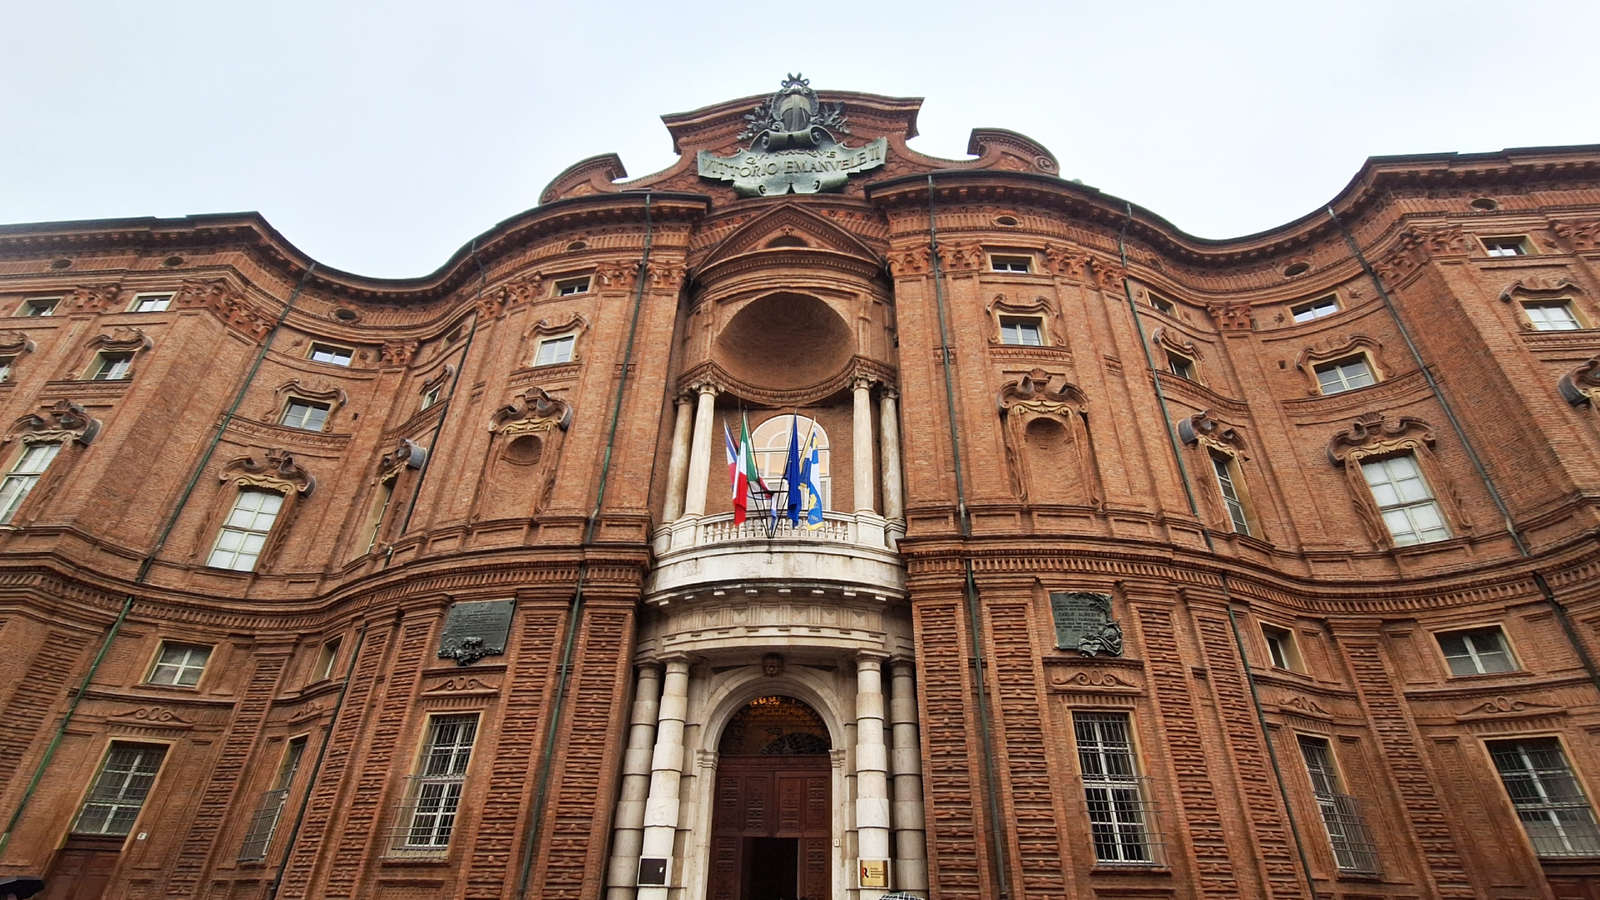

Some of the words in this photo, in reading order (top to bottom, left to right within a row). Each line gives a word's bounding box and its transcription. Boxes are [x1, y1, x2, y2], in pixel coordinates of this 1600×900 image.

[702, 158, 779, 178] VITTORIO
[784, 152, 867, 174] EMANVELE
[868, 146, 881, 162] II
